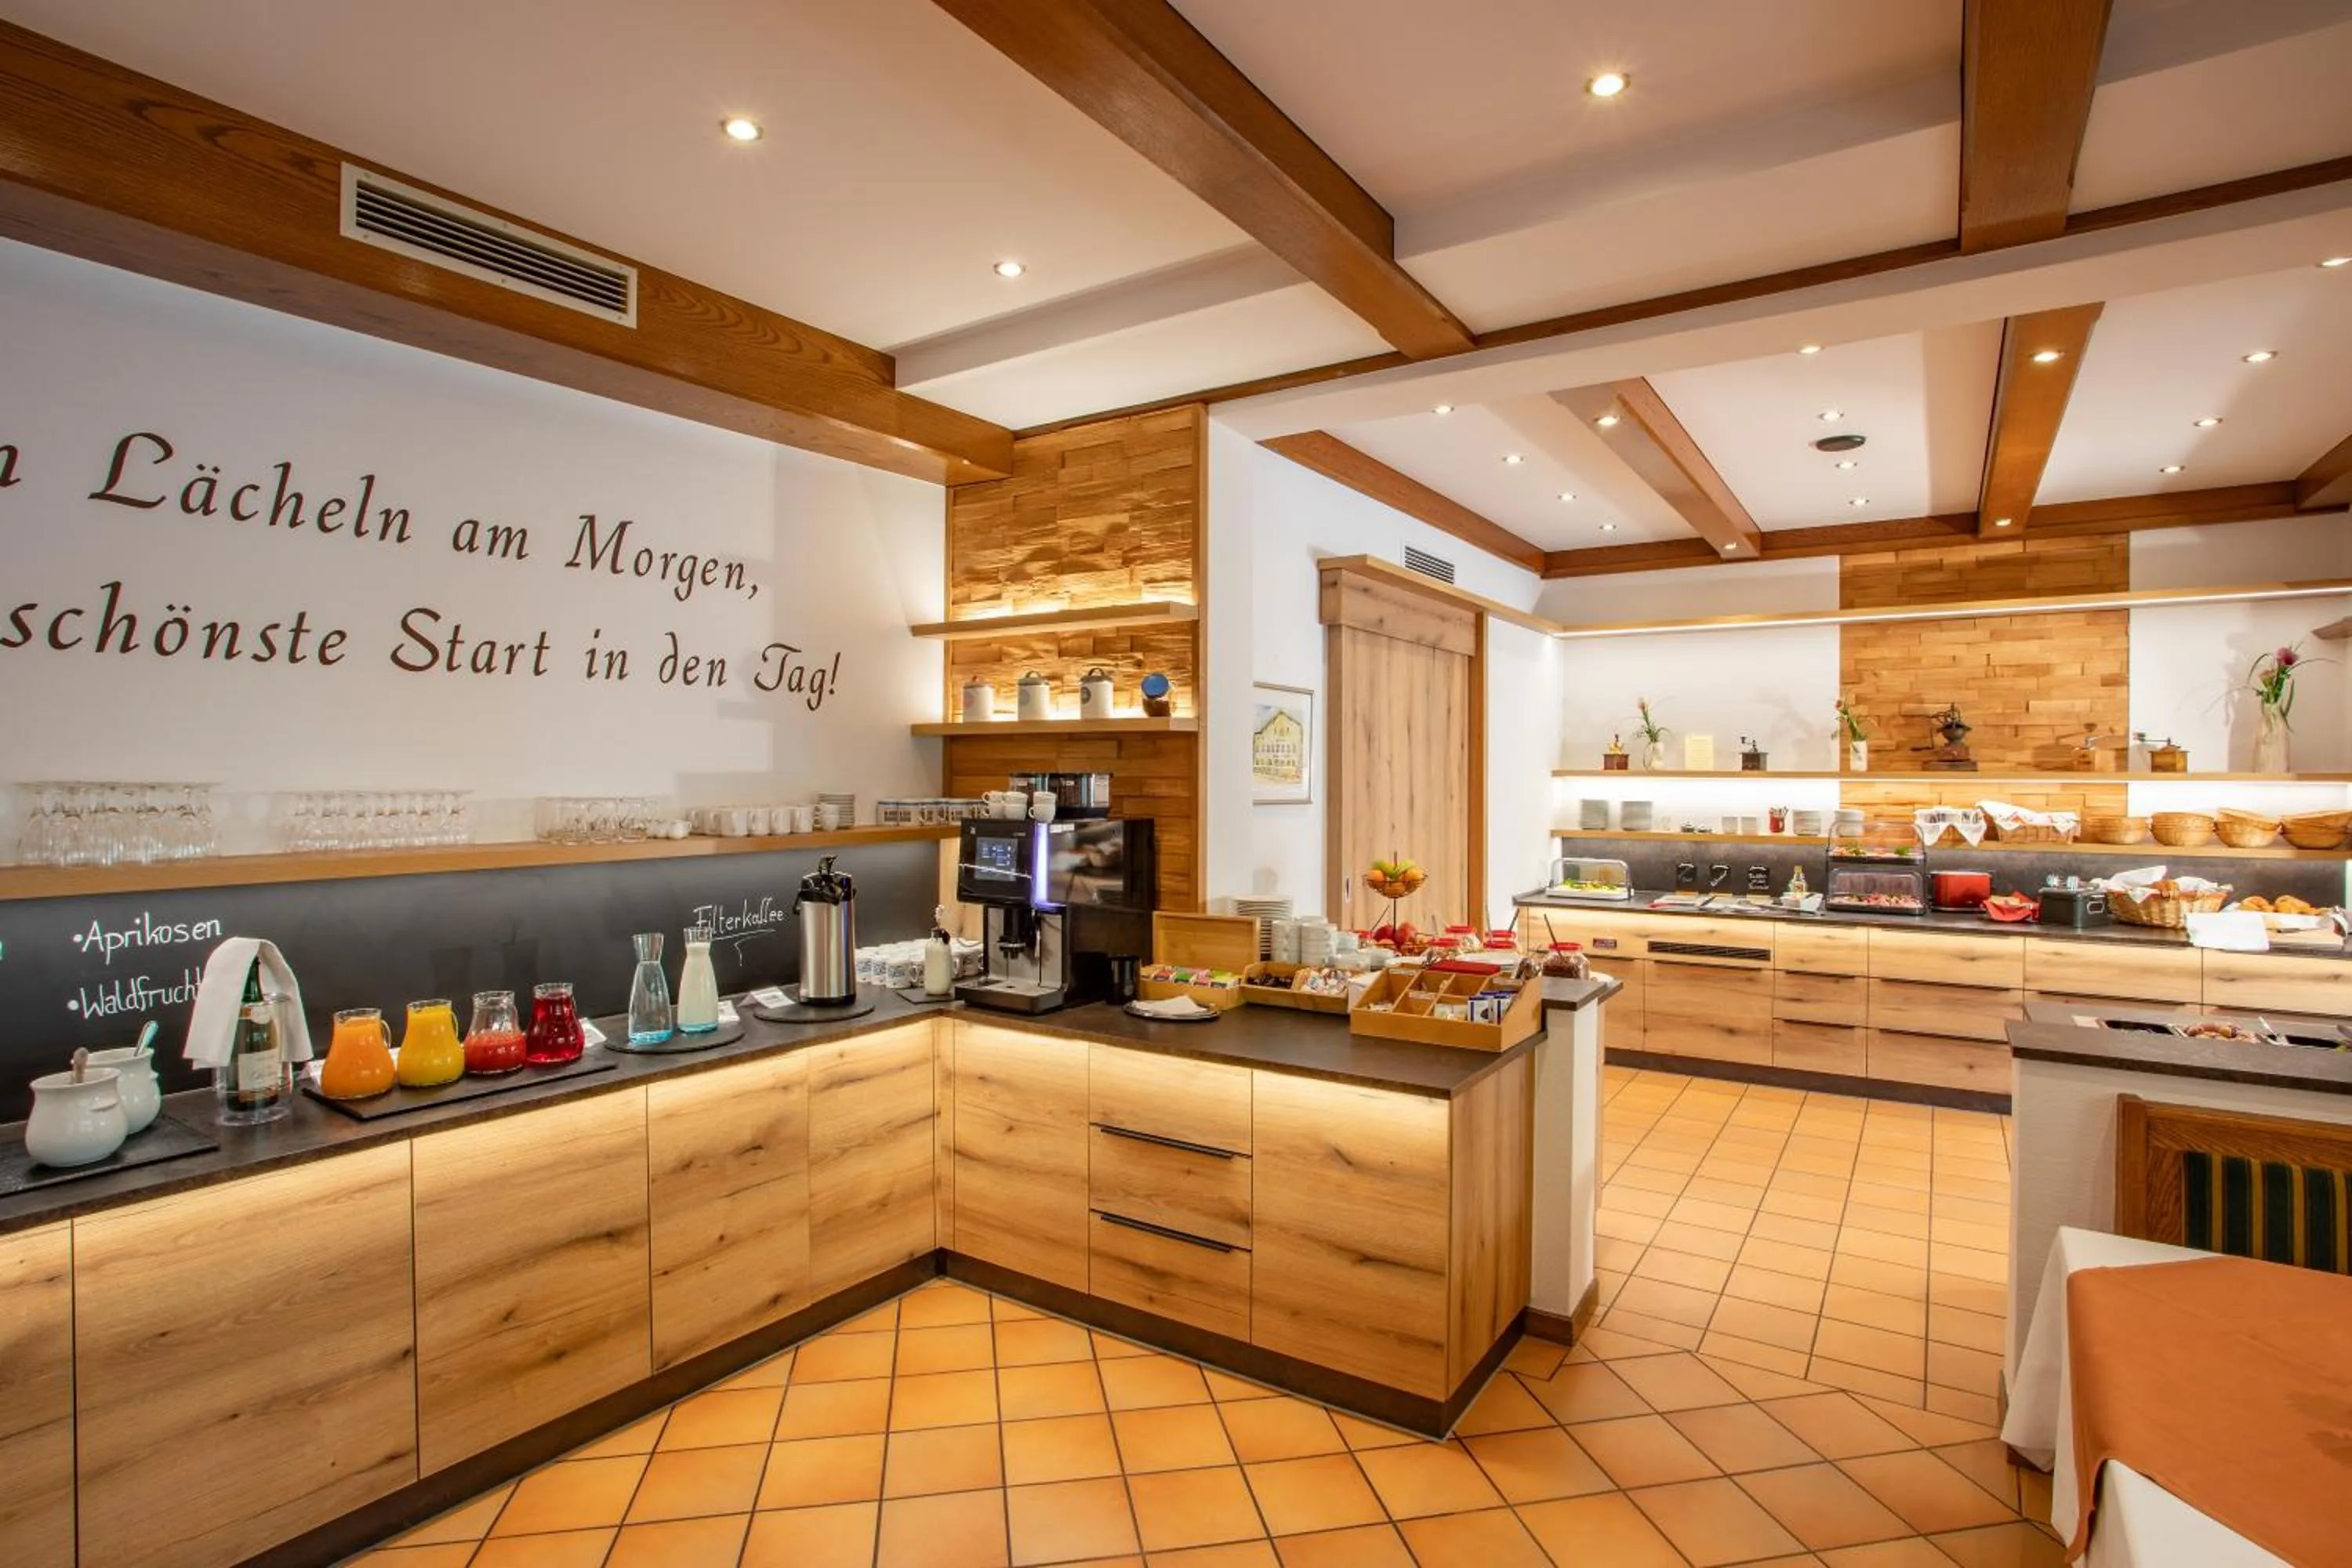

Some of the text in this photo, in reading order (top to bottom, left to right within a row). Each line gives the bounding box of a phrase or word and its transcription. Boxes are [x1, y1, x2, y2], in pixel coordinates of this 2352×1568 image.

[87, 432, 412, 543] Lächeln
[452, 518, 529, 561] am
[564, 514, 759, 602] Morgen,
[0, 580, 841, 712] schönste Start in den Tag!
[82, 911, 223, 965] Aprikosen
[692, 896, 784, 935] Filterkaffee
